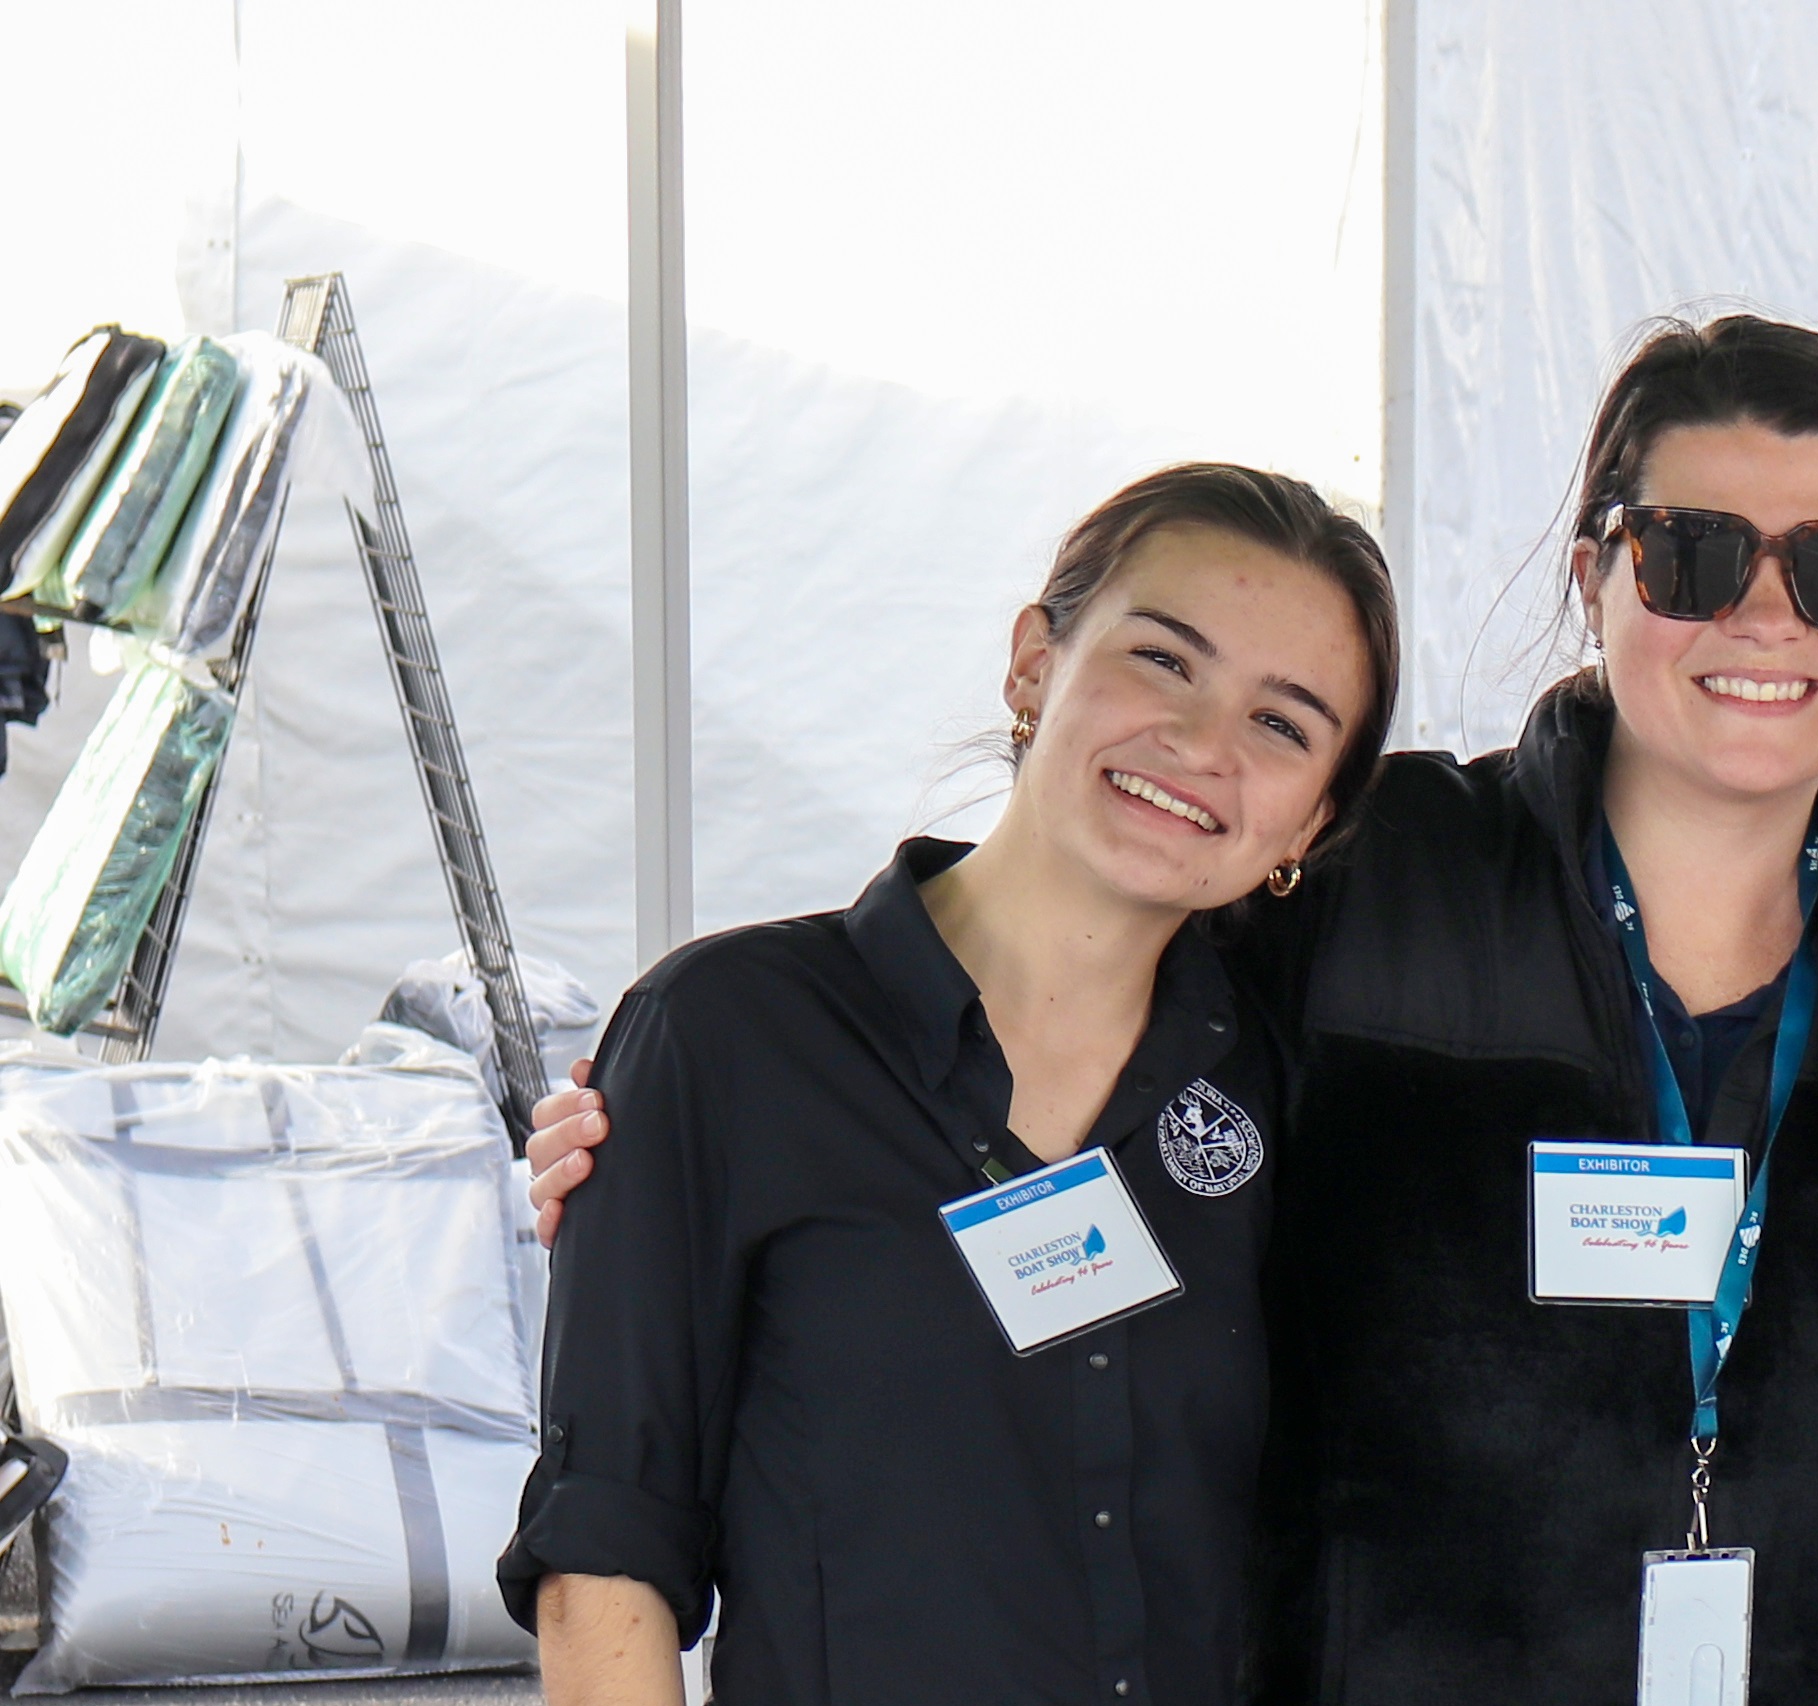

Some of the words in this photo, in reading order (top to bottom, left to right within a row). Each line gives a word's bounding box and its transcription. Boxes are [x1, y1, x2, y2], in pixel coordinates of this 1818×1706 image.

[1578, 1157, 1651, 1173] EXHIBITOR
[996, 1179, 1056, 1211] EXHIBITOR
[1569, 1203, 1663, 1217] CHARLESTON
[1749, 1210, 1759, 1224] SC
[1570, 1216, 1607, 1229] BOAT
[1611, 1218, 1653, 1231] SHOW
[1007, 1231, 1082, 1268] CHARLESTON
[1582, 1236, 1639, 1250] Celebrating
[1660, 1239, 1691, 1253] Years
[1014, 1260, 1045, 1281] BOAT
[1048, 1246, 1083, 1269] SHOW
[1737, 1246, 1749, 1266] DES
[1030, 1271, 1075, 1296] Celebrating
[1092, 1259, 1114, 1276] Years
